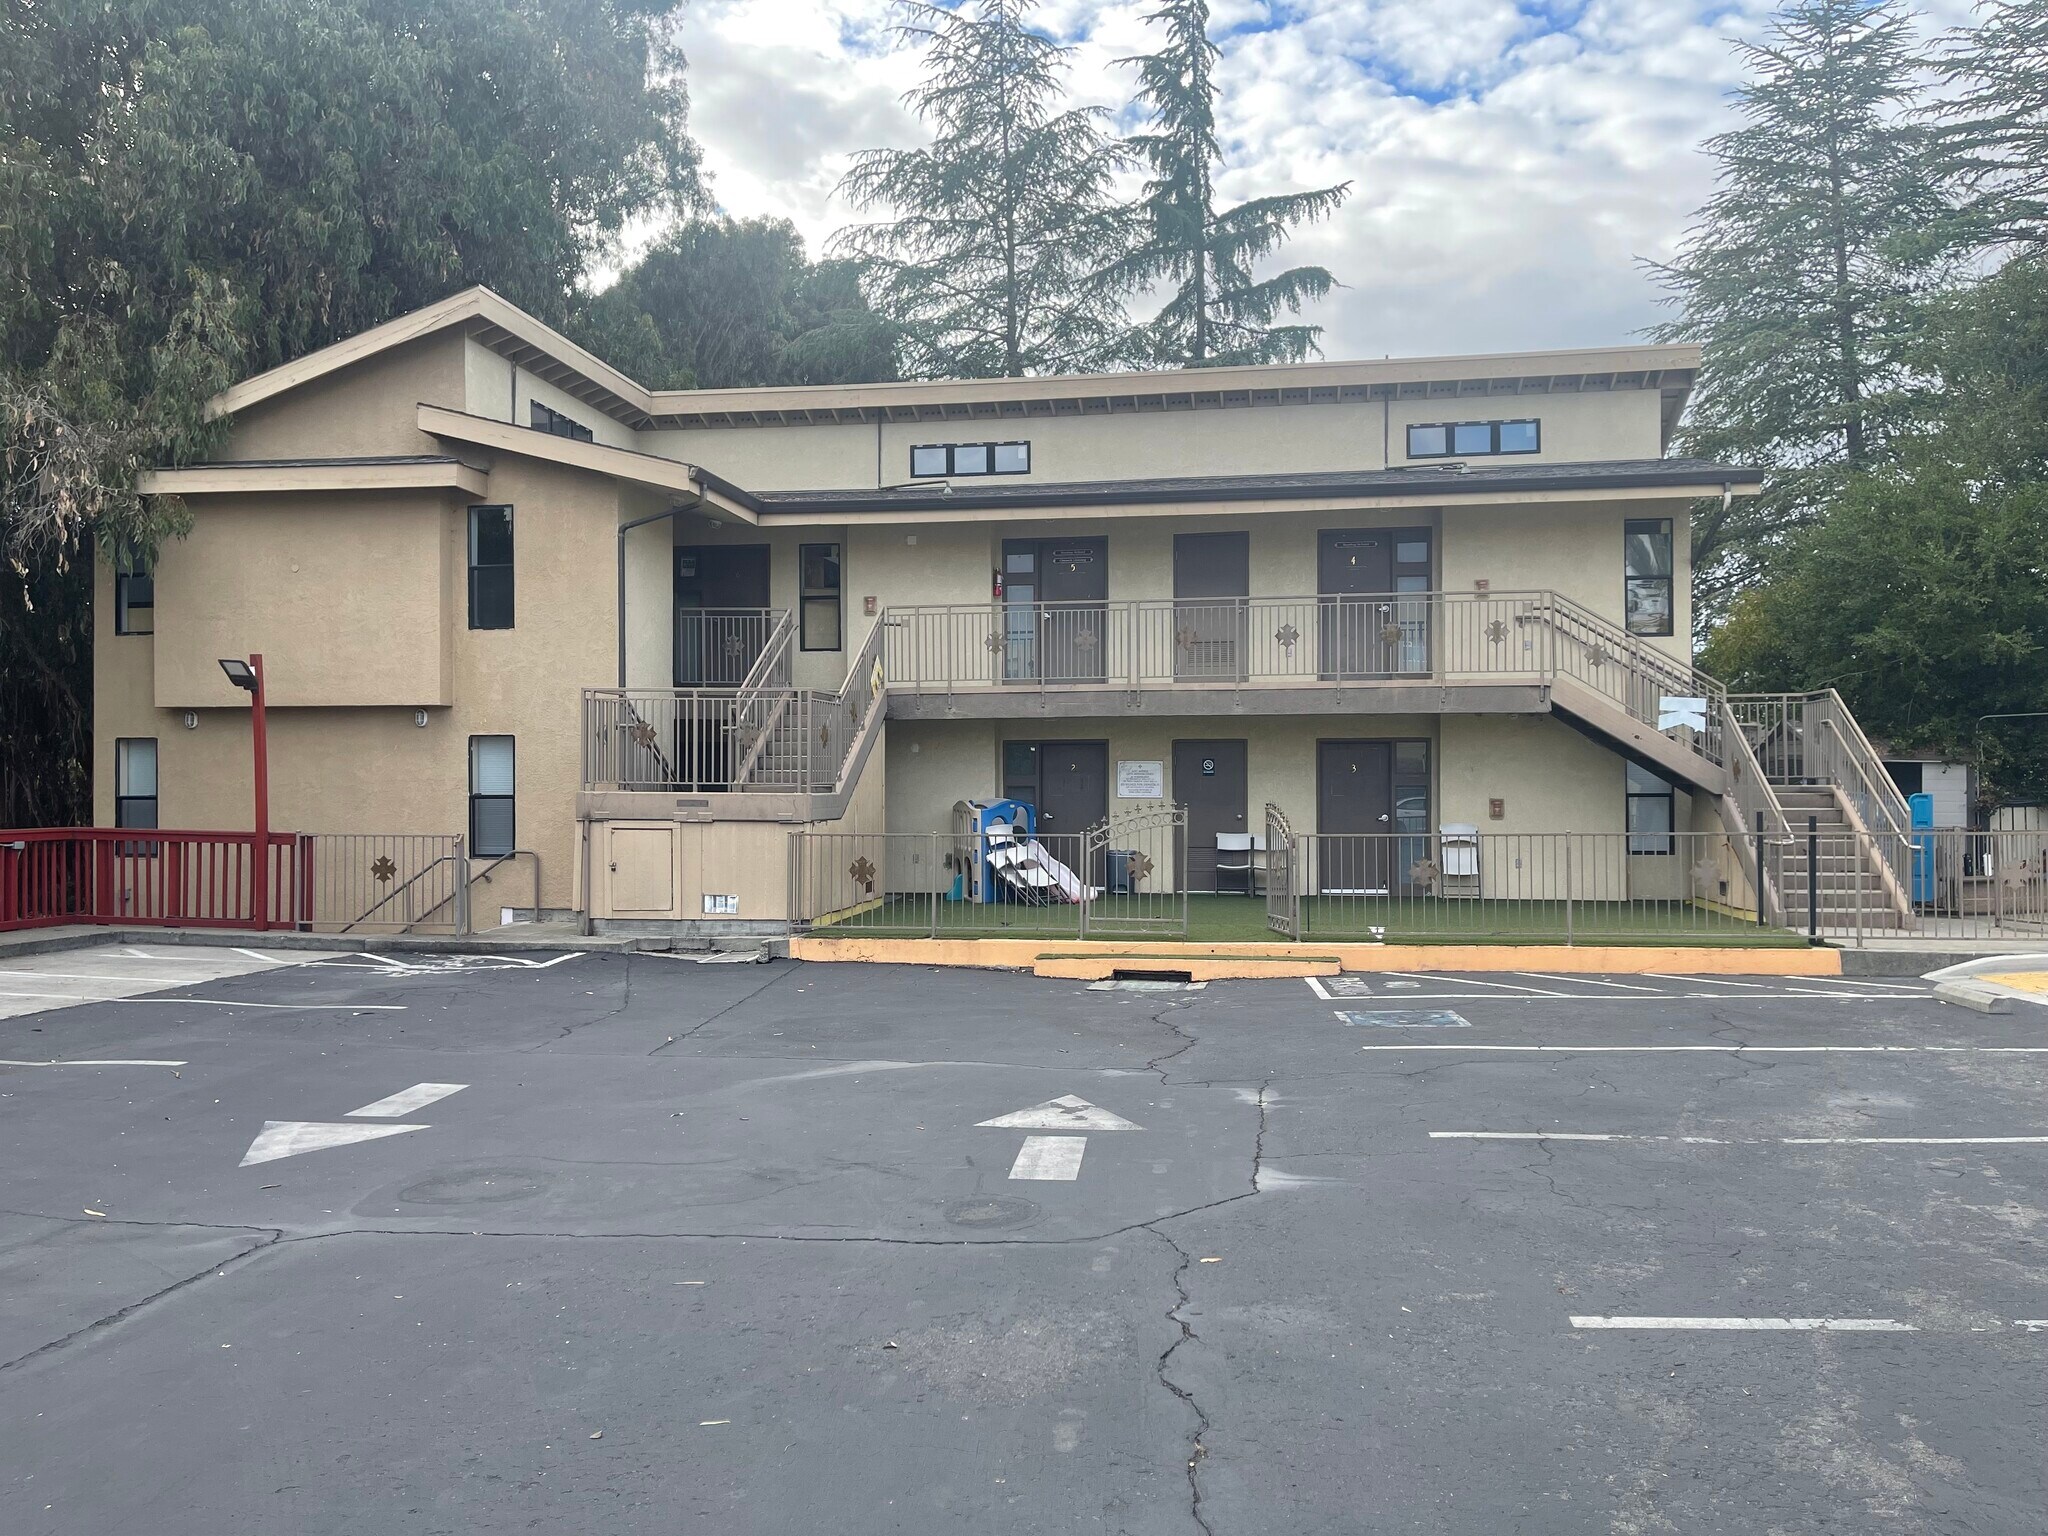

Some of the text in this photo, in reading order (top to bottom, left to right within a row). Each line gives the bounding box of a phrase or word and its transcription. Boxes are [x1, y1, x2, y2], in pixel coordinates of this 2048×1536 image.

[1351, 556, 1356, 565] 4
[1071, 563, 1076, 572] 5
[1070, 764, 1076, 772] 2
[1351, 764, 1357, 774] 3
